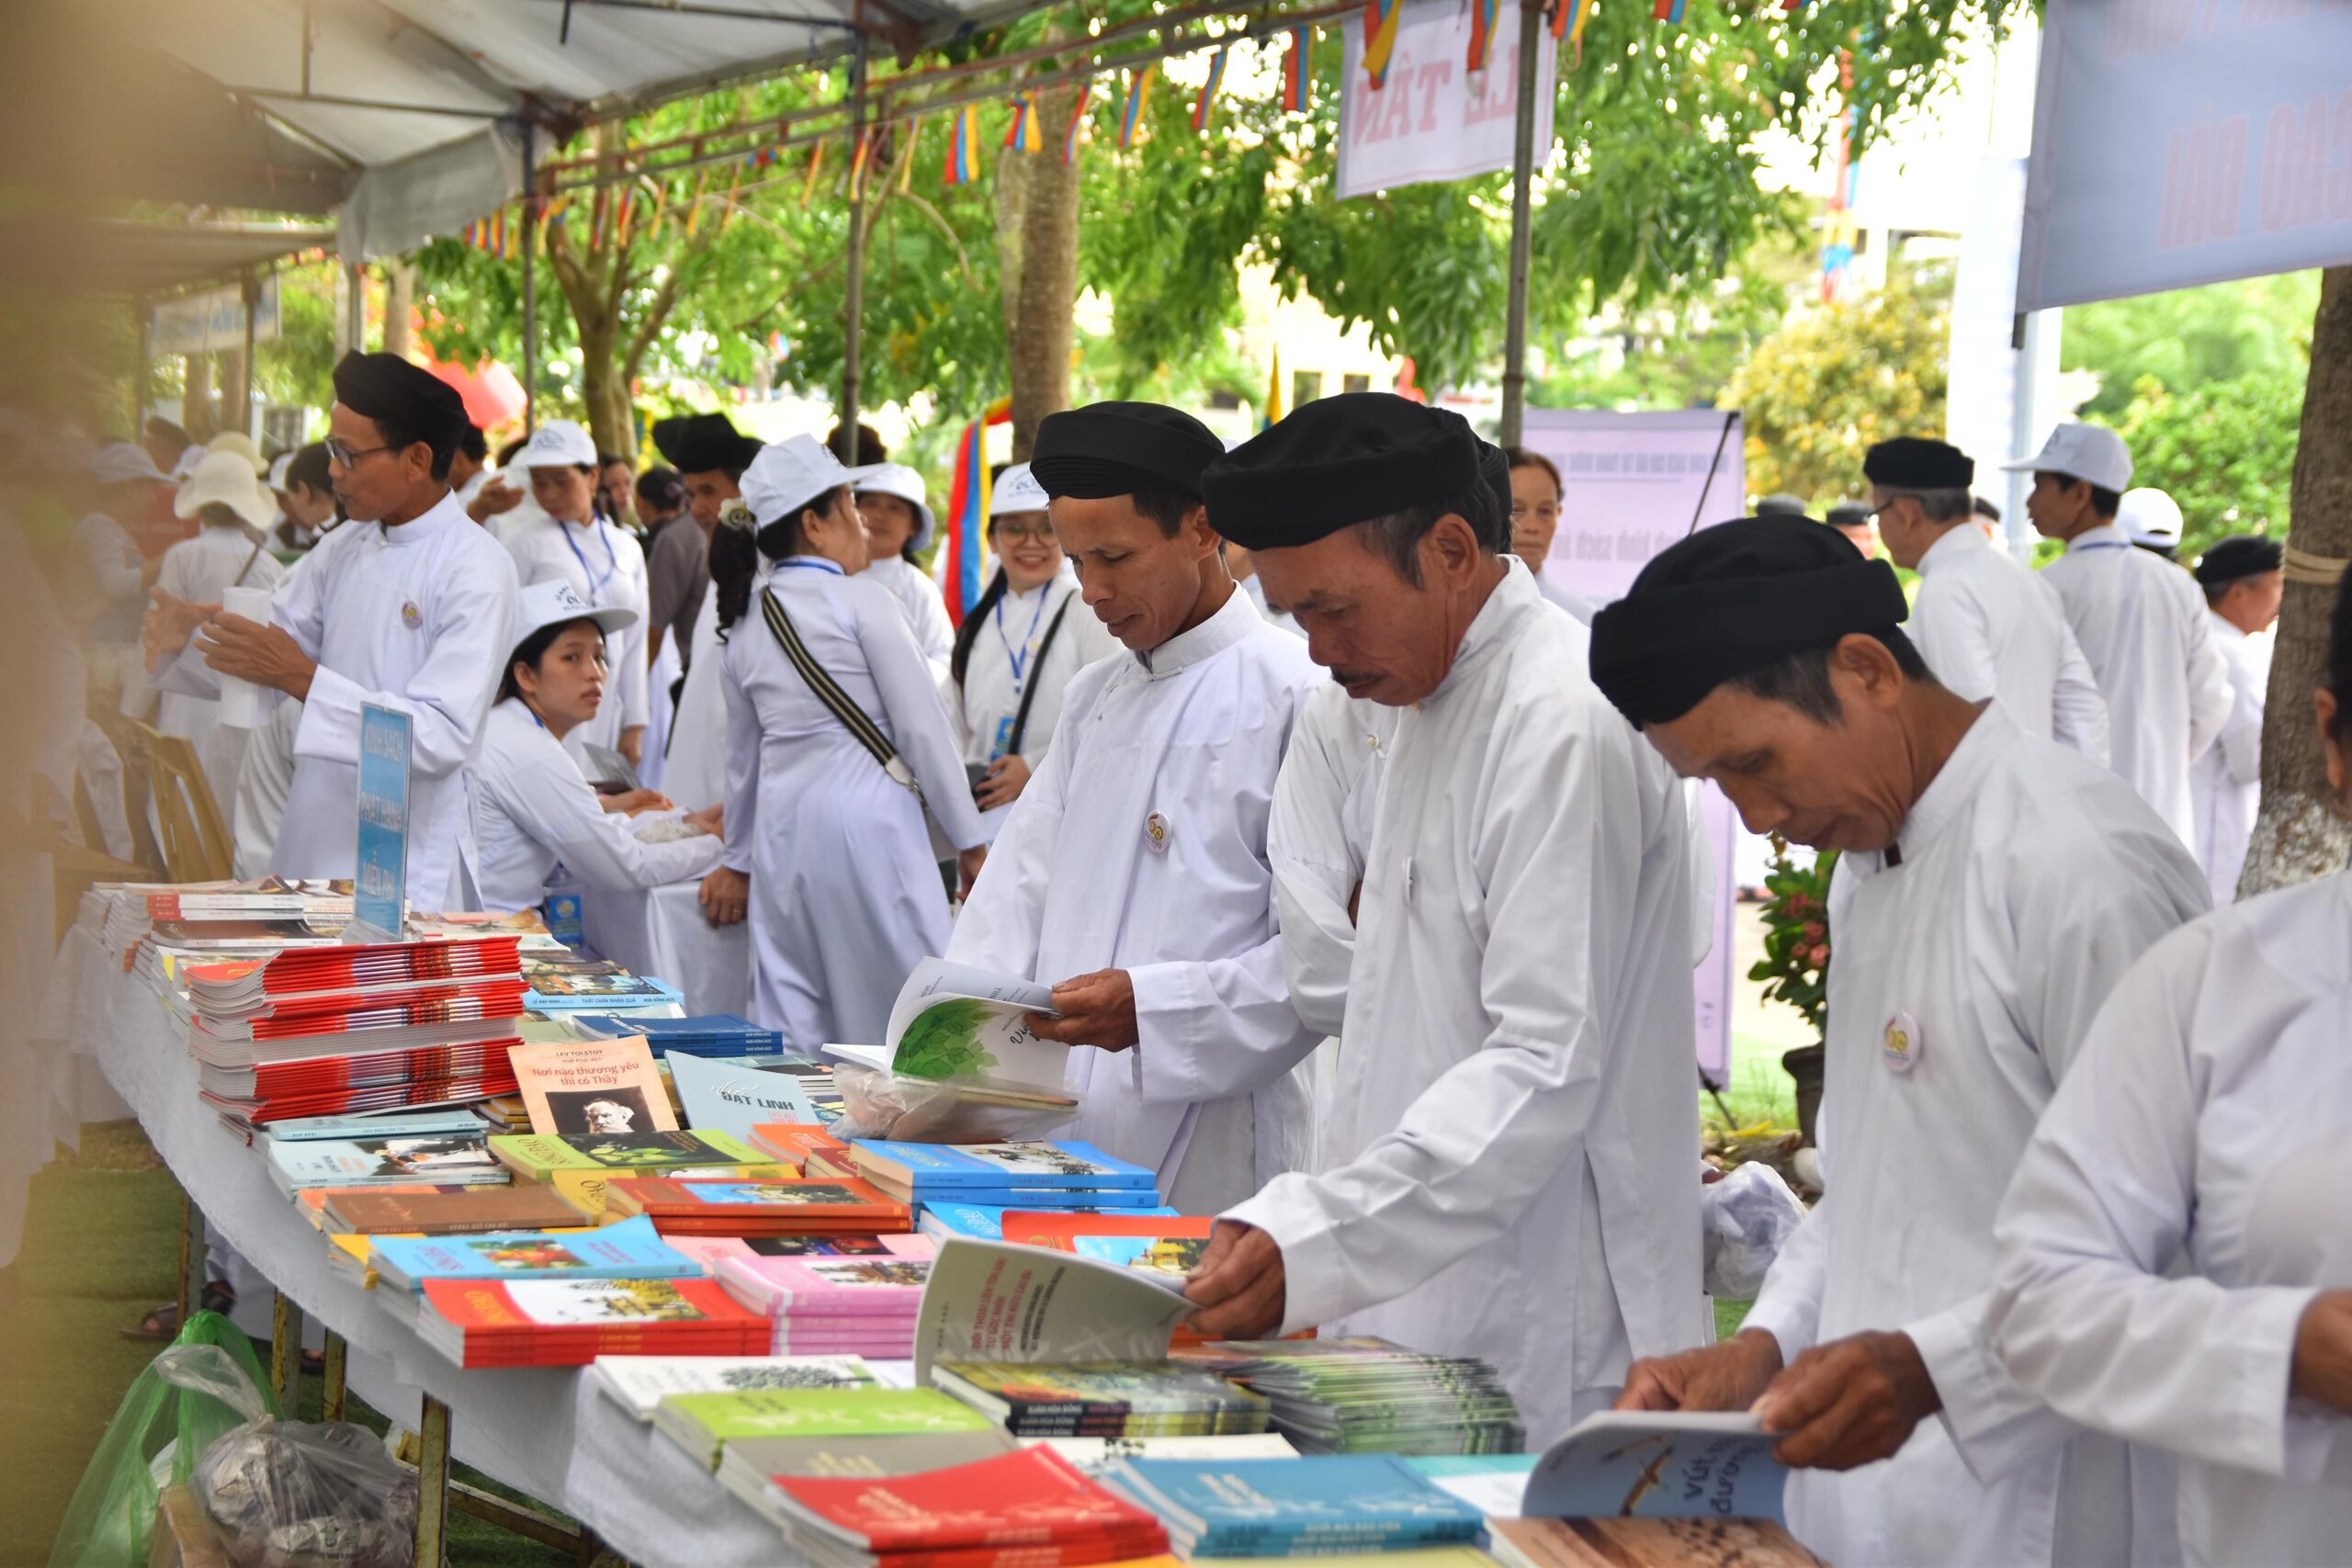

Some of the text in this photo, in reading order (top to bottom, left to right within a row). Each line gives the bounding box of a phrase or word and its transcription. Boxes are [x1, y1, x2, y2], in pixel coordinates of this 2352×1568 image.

[533, 1061, 639, 1076] Nơi nào thương yêu
[578, 1076, 590, 1085] có
[757, 1098, 796, 1111] LINH
